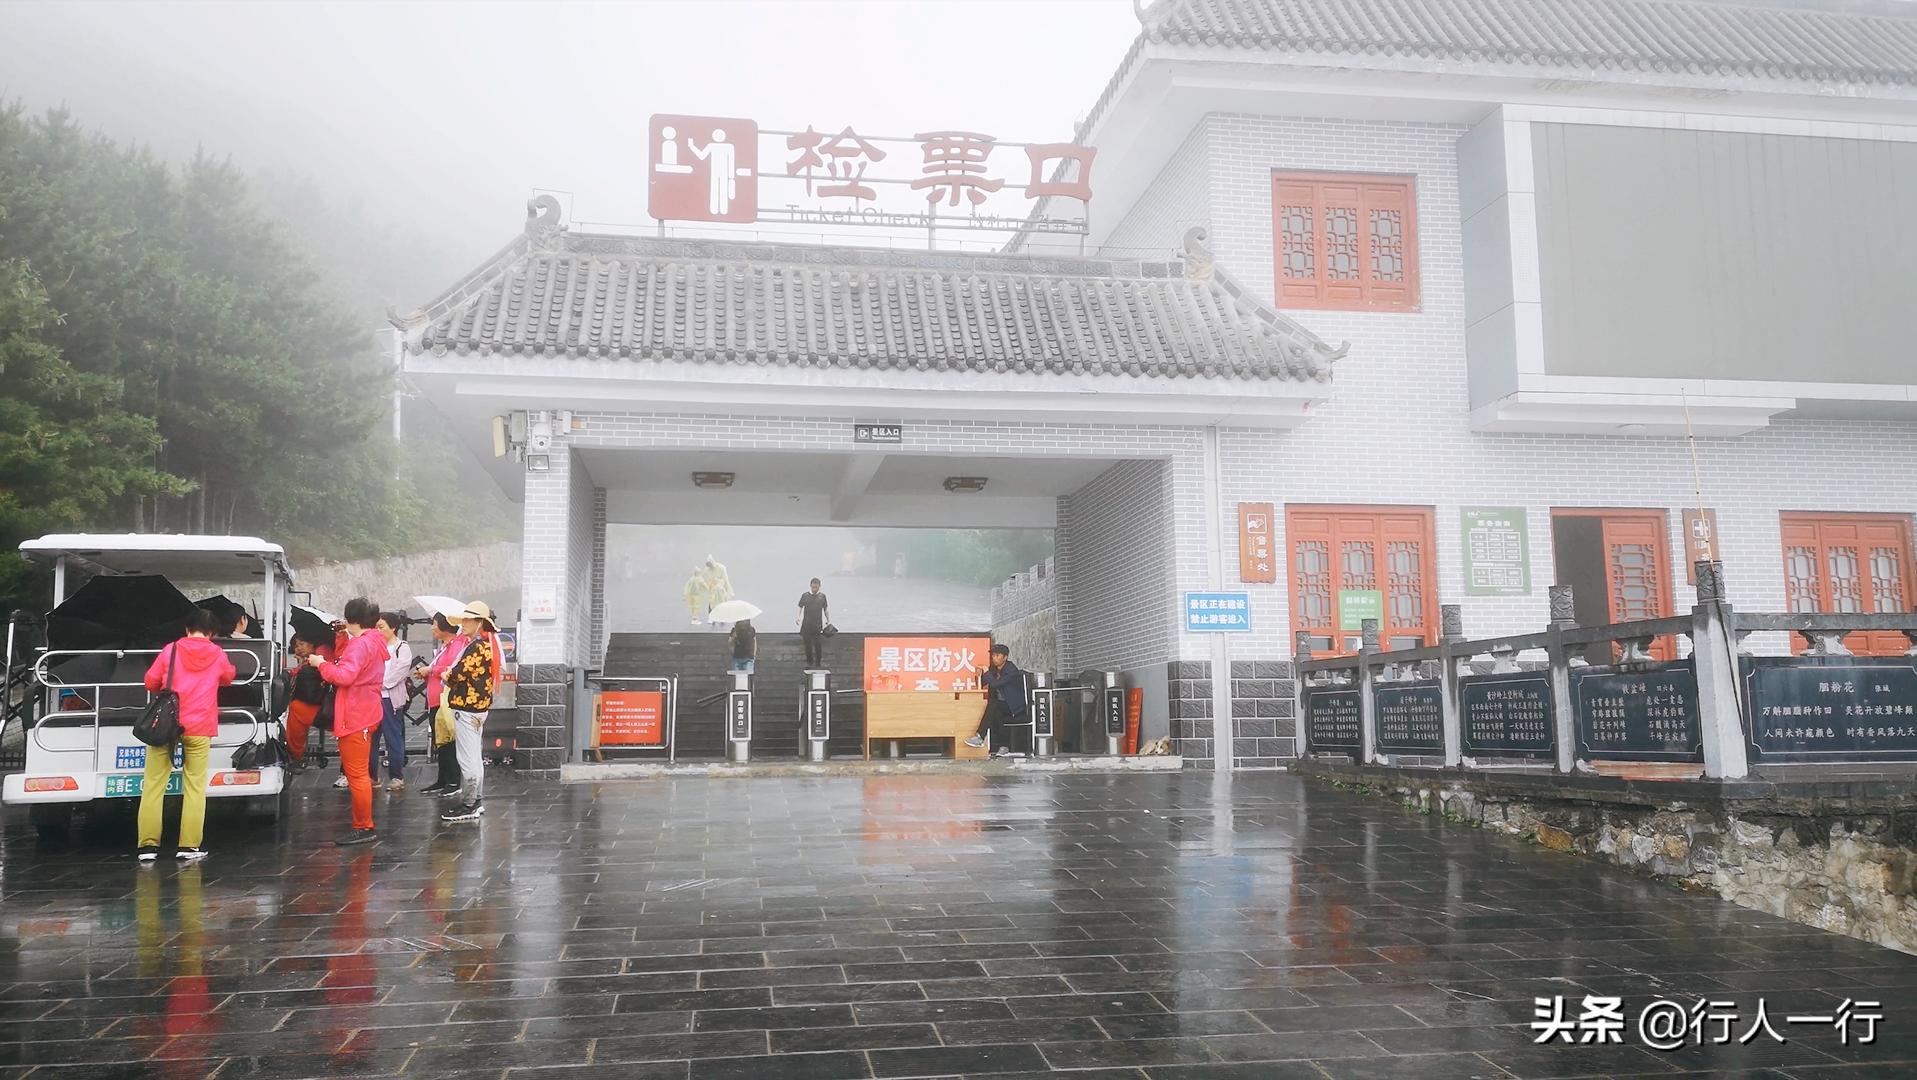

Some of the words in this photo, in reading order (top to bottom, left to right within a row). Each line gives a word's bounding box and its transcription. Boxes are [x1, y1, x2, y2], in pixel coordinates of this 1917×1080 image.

[786, 124, 1097, 206] 检票口
[786, 203, 855, 225] Ticket
[861, 207, 932, 228] Check
[872, 427, 899, 436] 景区入口
[1256, 536, 1269, 572] 售票处
[1190, 599, 1246, 609] 景区正在建设
[1190, 614, 1246, 625] 禁止游客进入
[877, 647, 976, 672] 景区防火
[898, 677, 976, 690] 查站
[1039, 697, 1047, 722] 团队入口
